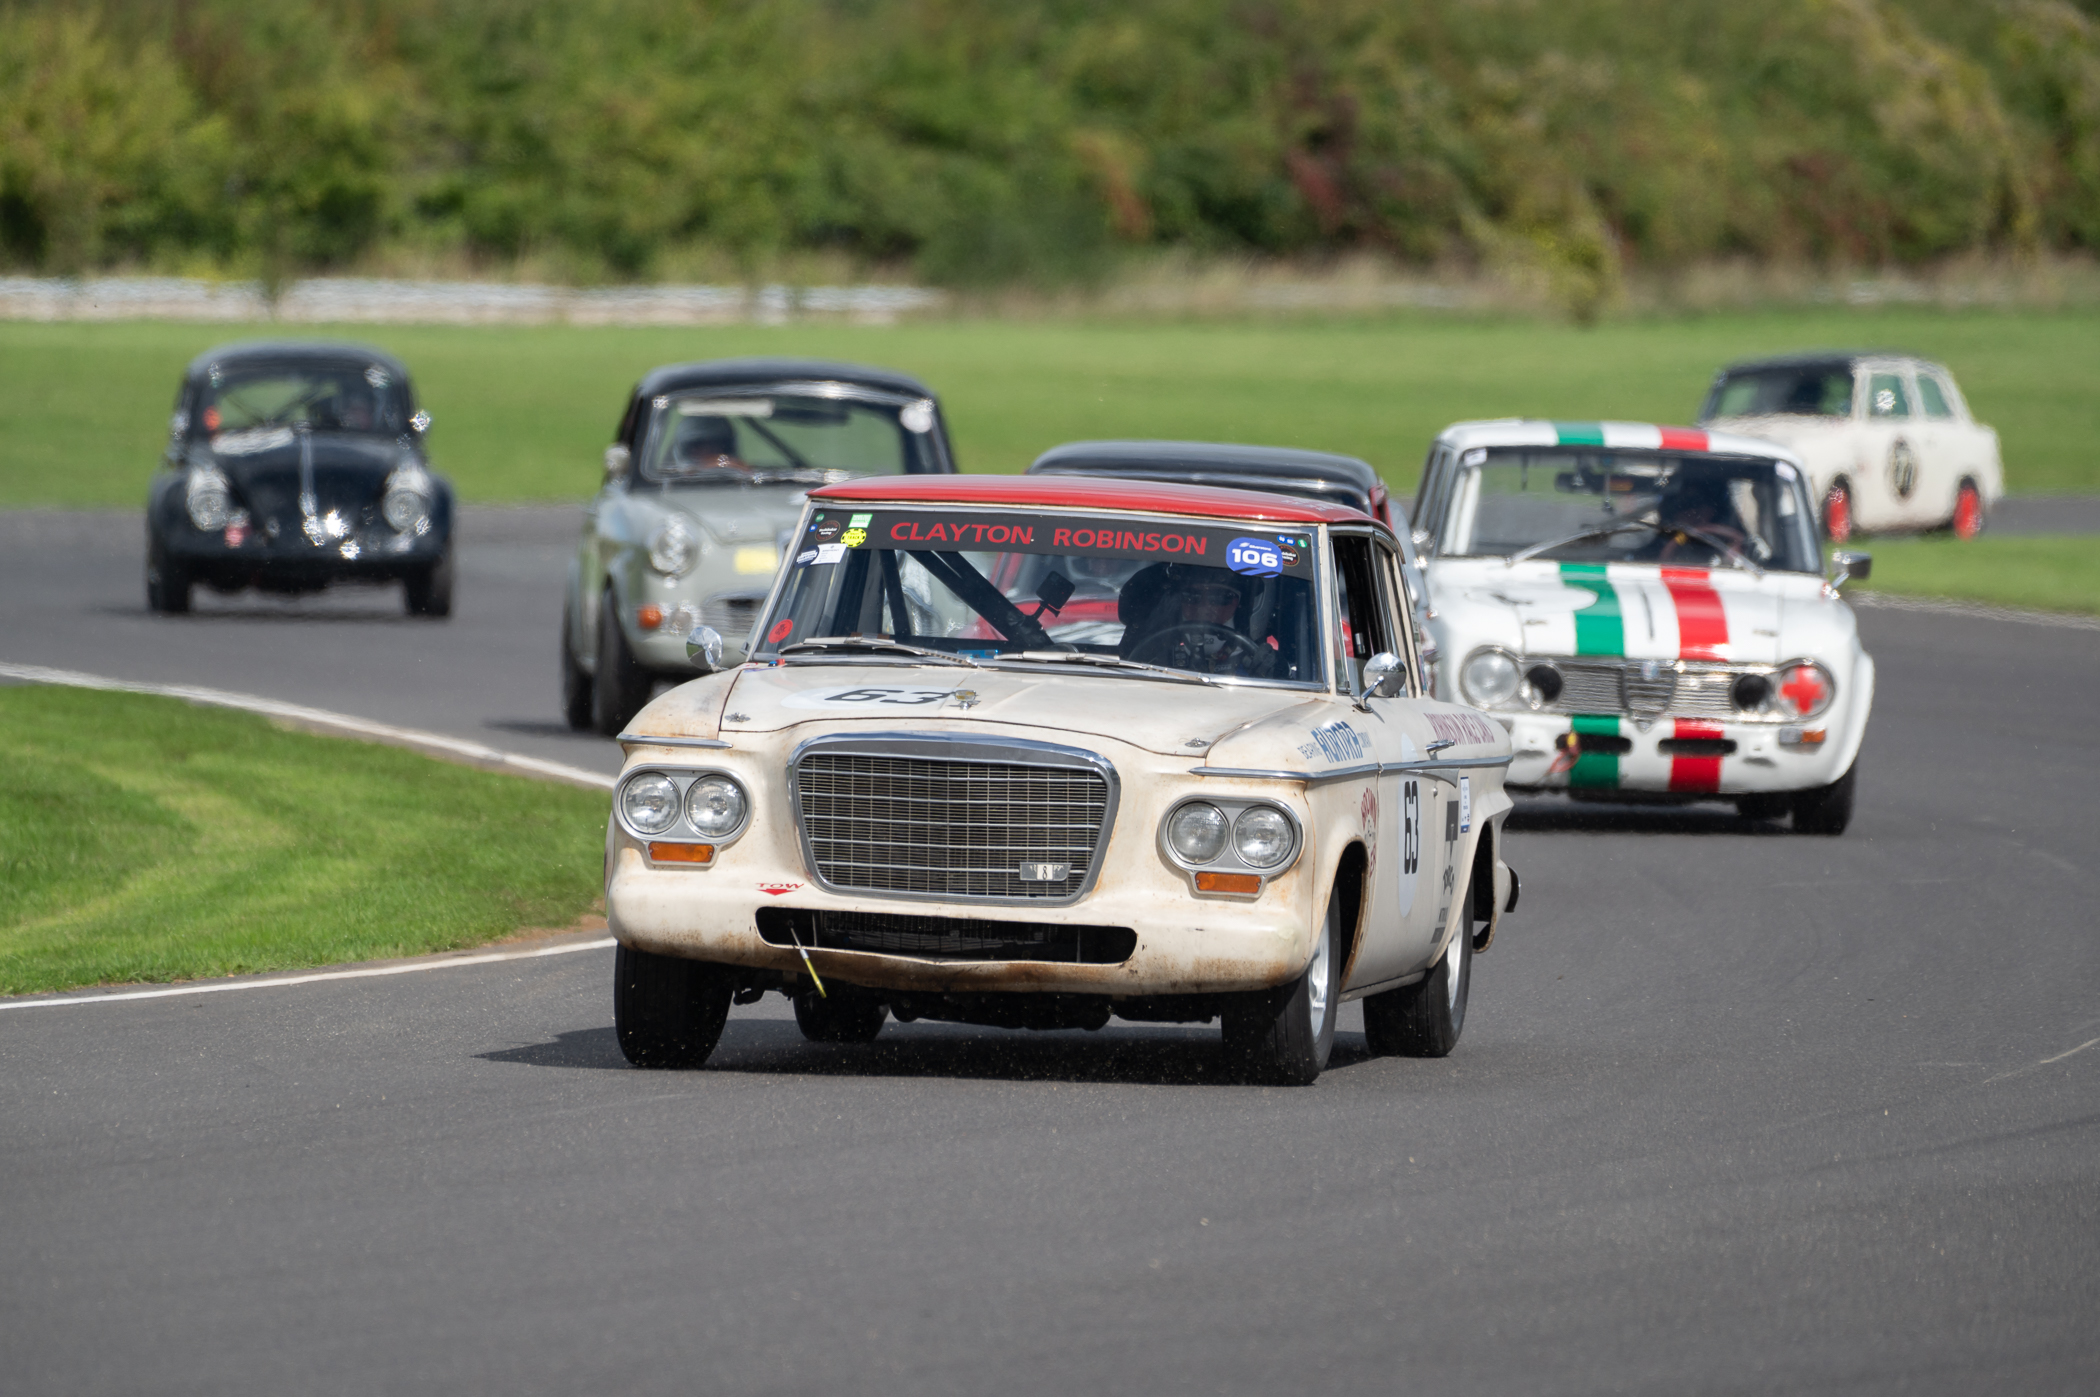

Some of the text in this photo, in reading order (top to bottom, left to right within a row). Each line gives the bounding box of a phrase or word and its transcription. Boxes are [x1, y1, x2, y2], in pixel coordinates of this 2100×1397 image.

[890, 522, 1207, 555] CLAYTON ROBINSON
[1231, 548, 1278, 568] 106
[824, 688, 955, 705] 63
[1404, 780, 1419, 875] 63
